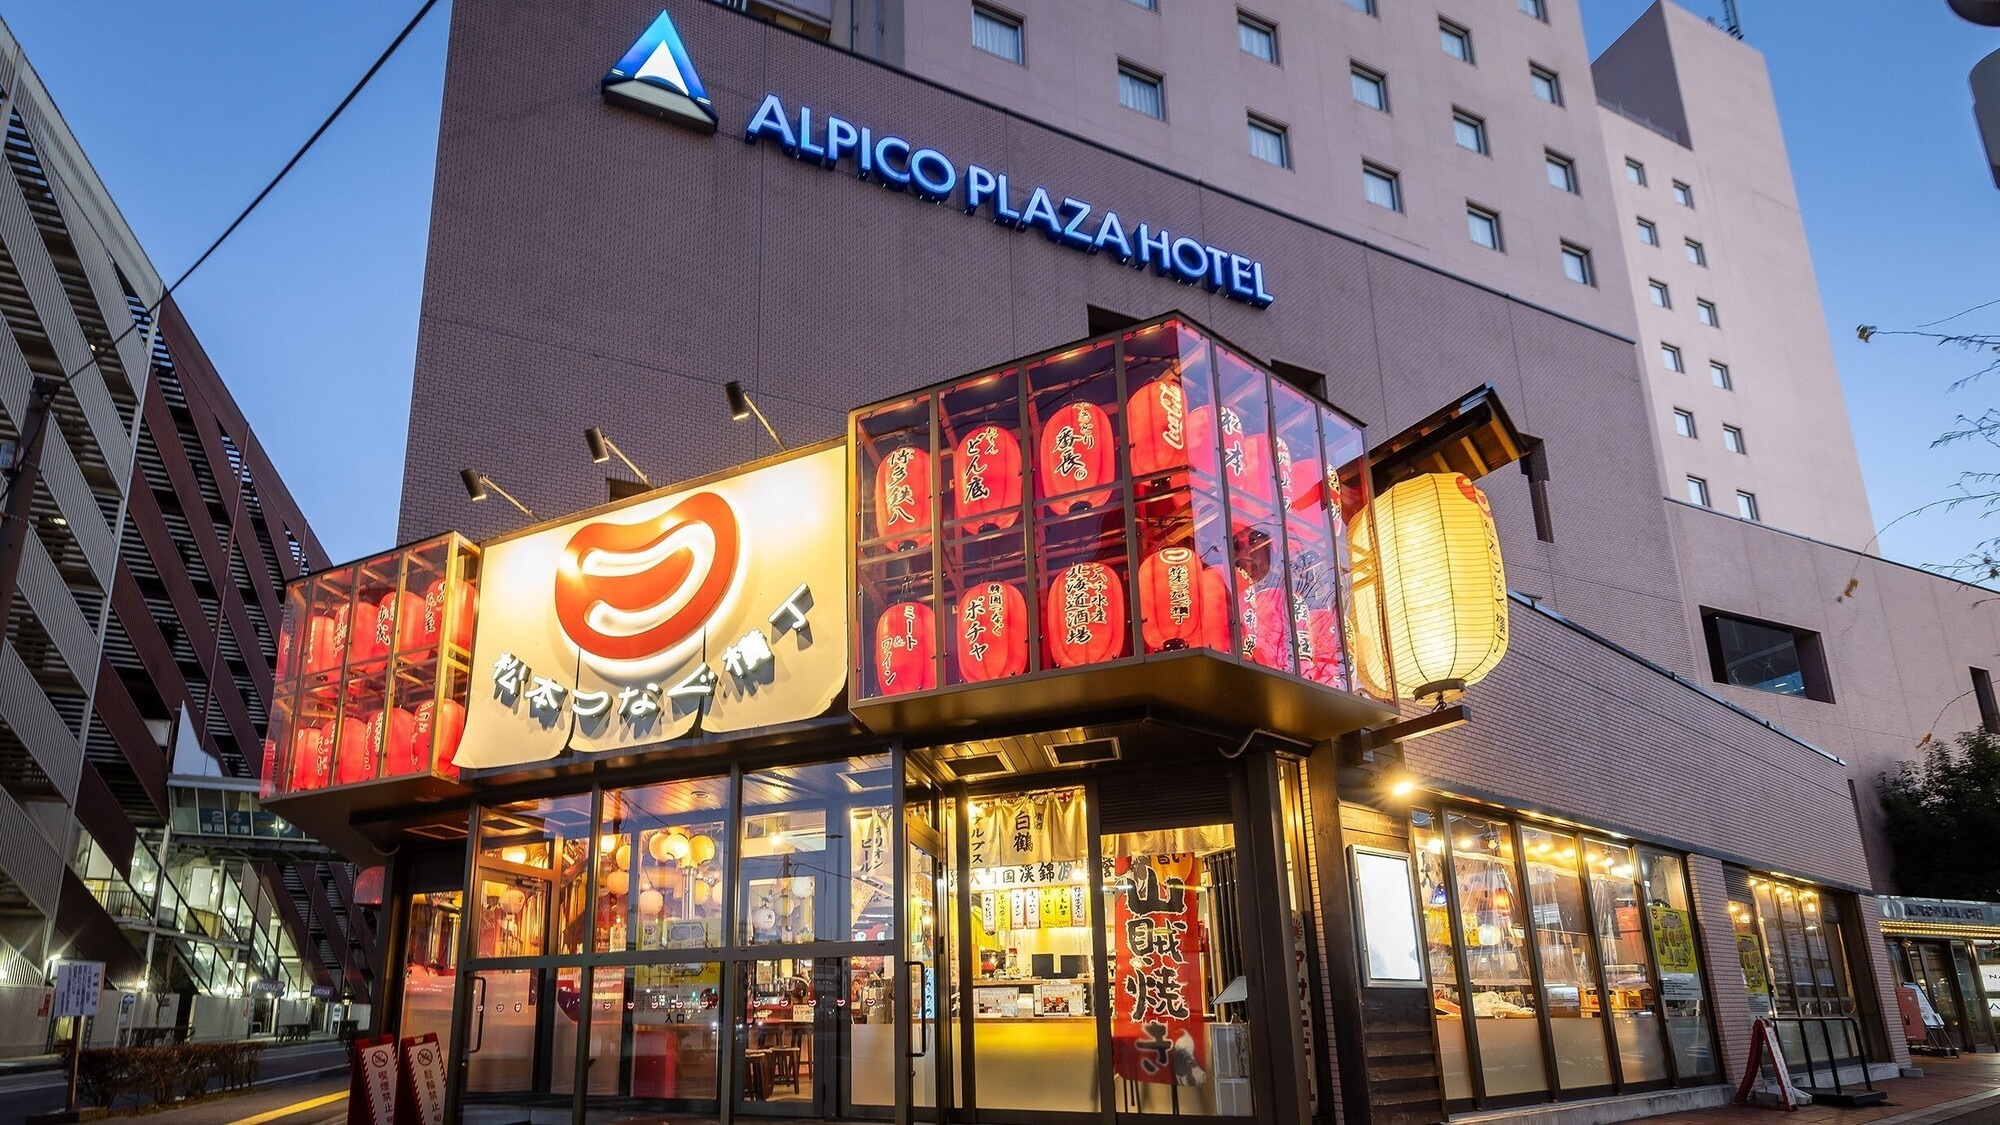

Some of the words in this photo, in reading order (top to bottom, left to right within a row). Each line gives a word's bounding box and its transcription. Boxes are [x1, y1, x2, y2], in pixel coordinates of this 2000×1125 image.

[746, 93, 957, 198] ALPICO
[965, 164, 1133, 262] PLAZA
[1134, 222, 1274, 305] HOTEL
[963, 434, 990, 504] どん底
[904, 605, 918, 652] ミート
[1065, 564, 1093, 646] 北海道酒場
[492, 582, 814, 718] 松本つなぐ横丁
[881, 637, 897, 687] ワイン
[860, 838, 873, 874] ビール
[873, 826, 885, 871] オリオン
[1013, 810, 1034, 853] 白鶴
[1124, 865, 1190, 1075] 山賊焼き
[664, 1013, 685, 1024] 入口
